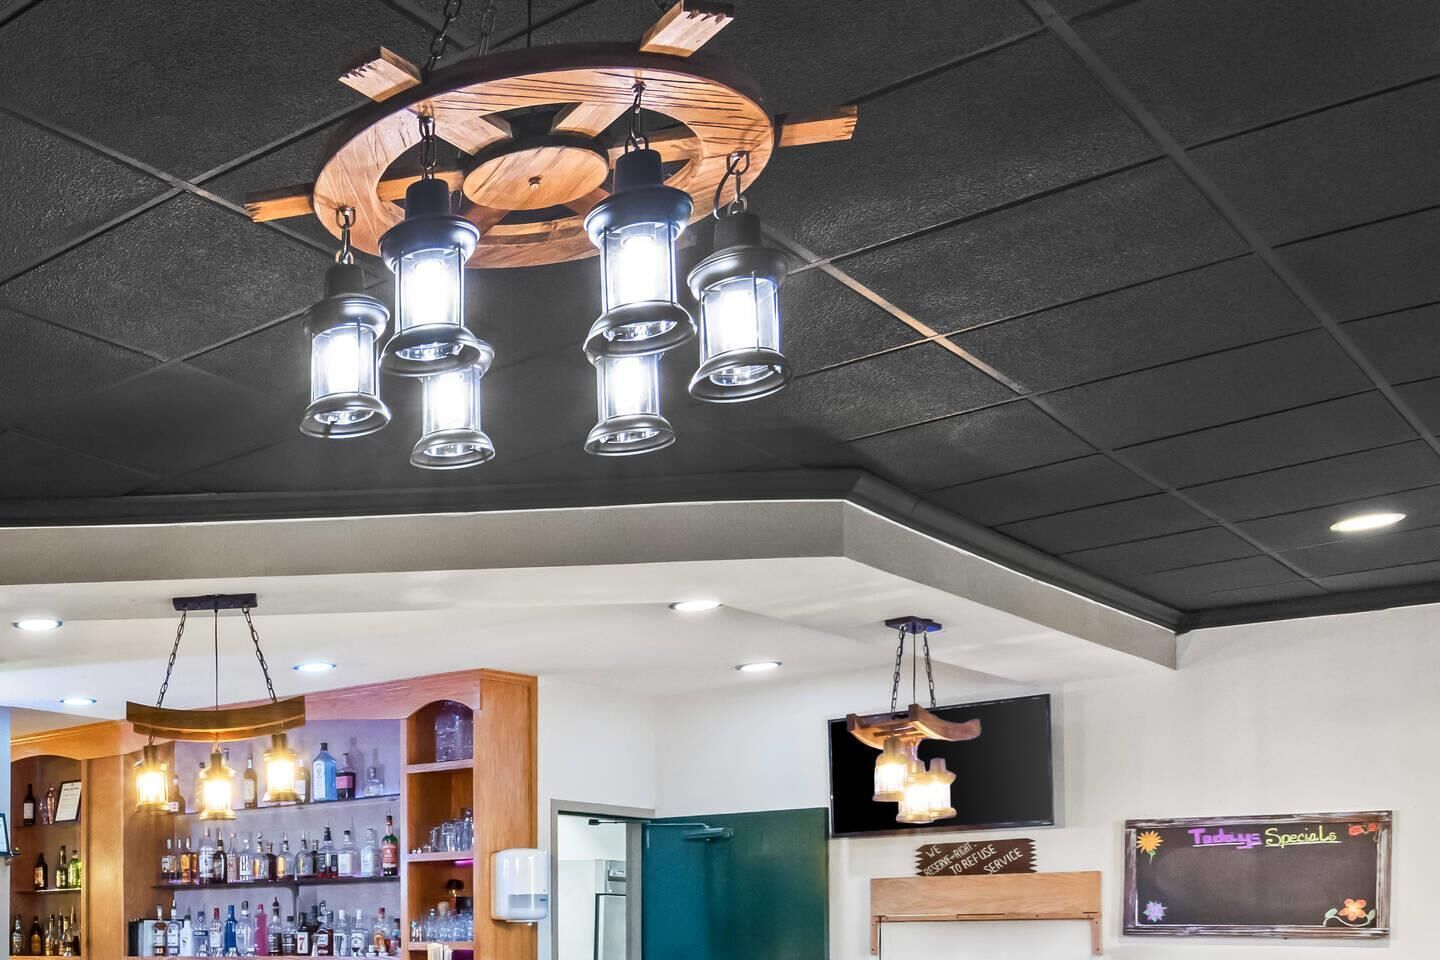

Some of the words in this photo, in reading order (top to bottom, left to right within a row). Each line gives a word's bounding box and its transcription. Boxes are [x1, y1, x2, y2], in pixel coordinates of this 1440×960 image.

[1264, 824, 1338, 849] Specials
[924, 844, 942, 858] WE
[949, 863, 962, 875] TO
[960, 843, 998, 870] REFUSE
[983, 847, 1024, 875] SERVICE
[923, 854, 953, 877] RESERVE
